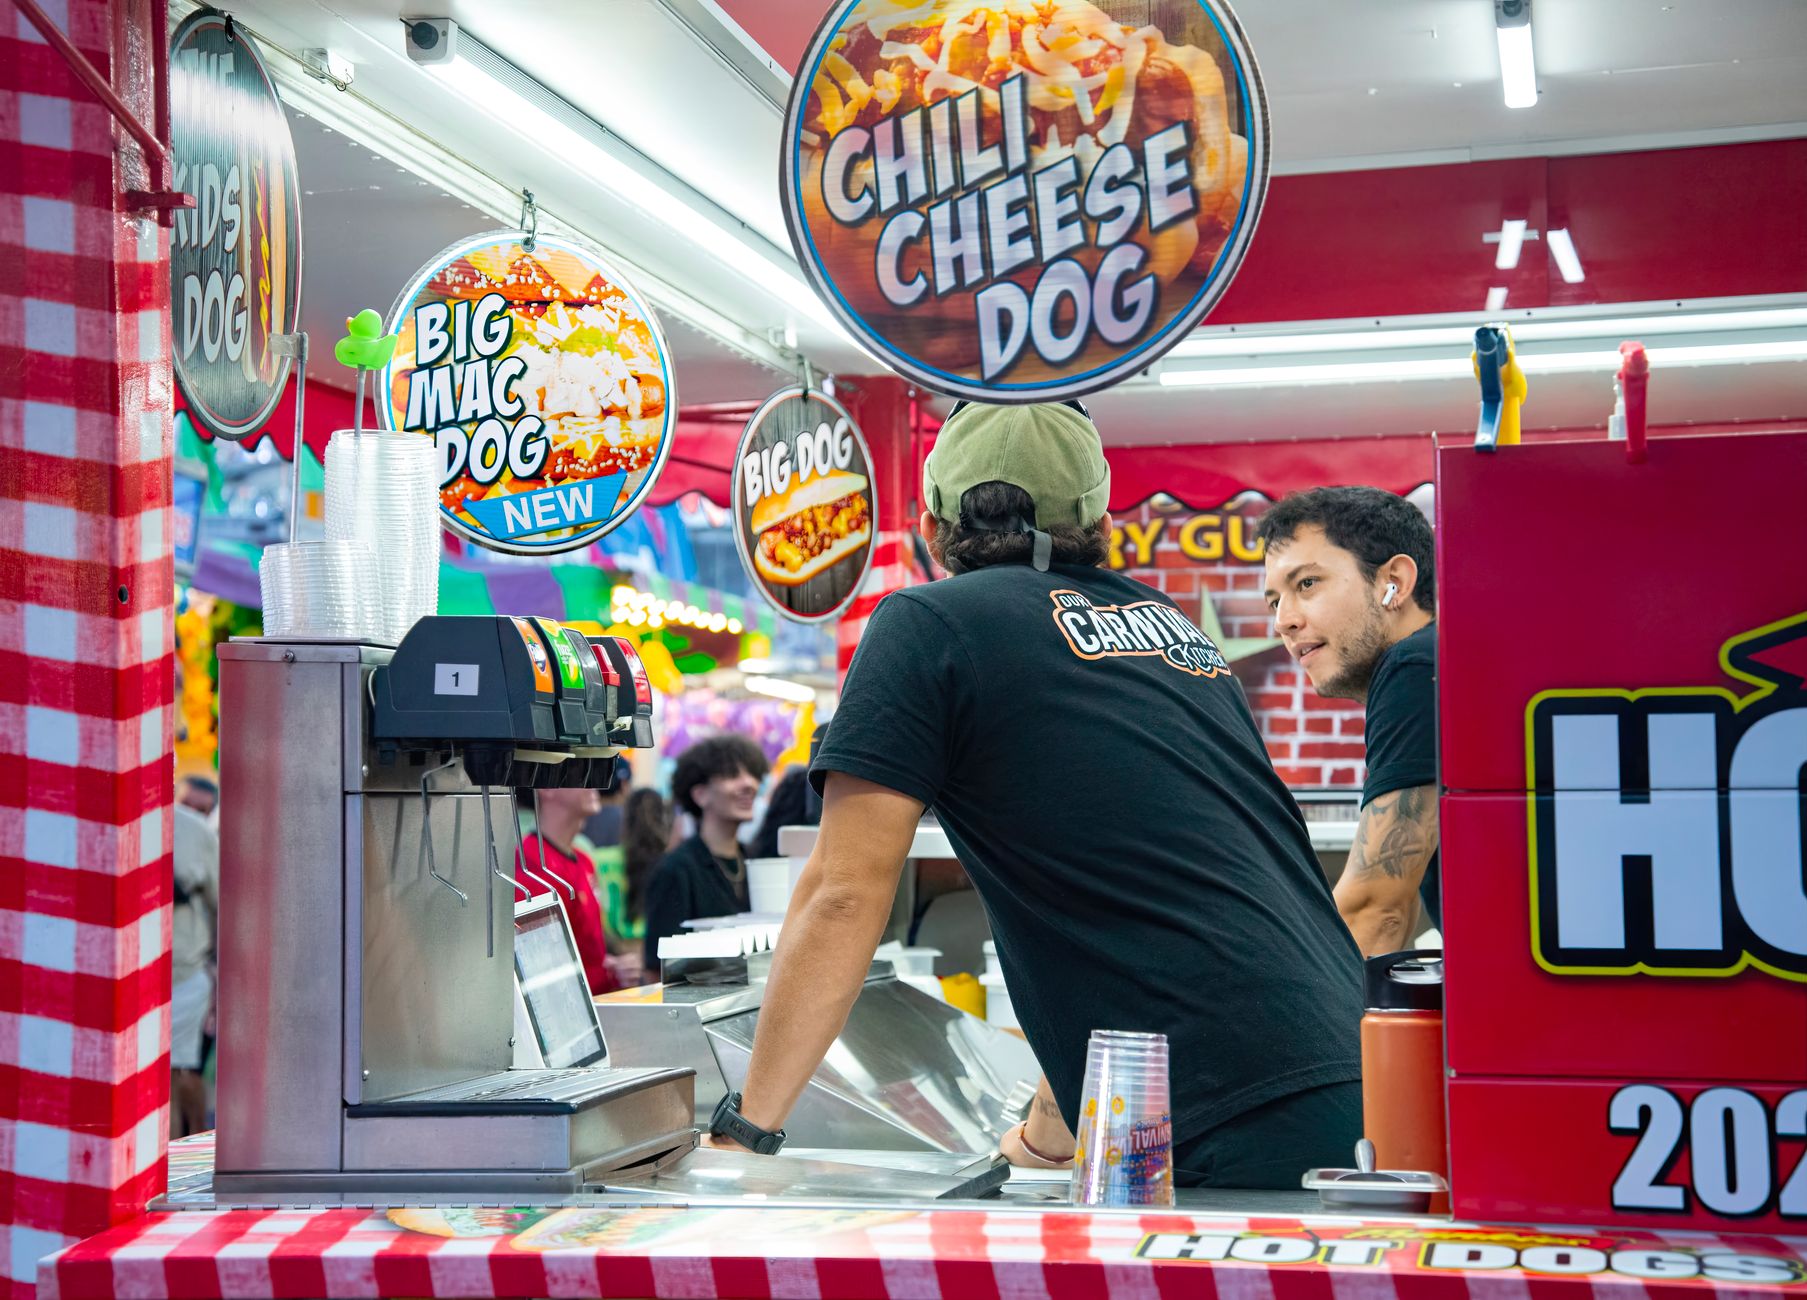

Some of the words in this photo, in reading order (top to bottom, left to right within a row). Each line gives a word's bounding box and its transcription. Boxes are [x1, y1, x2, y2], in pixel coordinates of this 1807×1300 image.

[821, 73, 1028, 223] CHILI
[171, 163, 241, 253] KIDS
[876, 121, 1194, 305] CHEESE
[184, 270, 247, 364] DOG
[415, 293, 512, 366] BIG
[976, 243, 1156, 382] DOG
[404, 356, 527, 431] MAC
[436, 415, 549, 487] DOG
[743, 440, 791, 506] BIG
[796, 417, 853, 485] DOG
[502, 484, 593, 533] NEW
[1059, 594, 1089, 608] OUR
[1062, 605, 1216, 653] CARNIVAL
[452, 671, 459, 687] 1
[1142, 1233, 1393, 1265] HOT
[1429, 1241, 1798, 1282] DOGS
